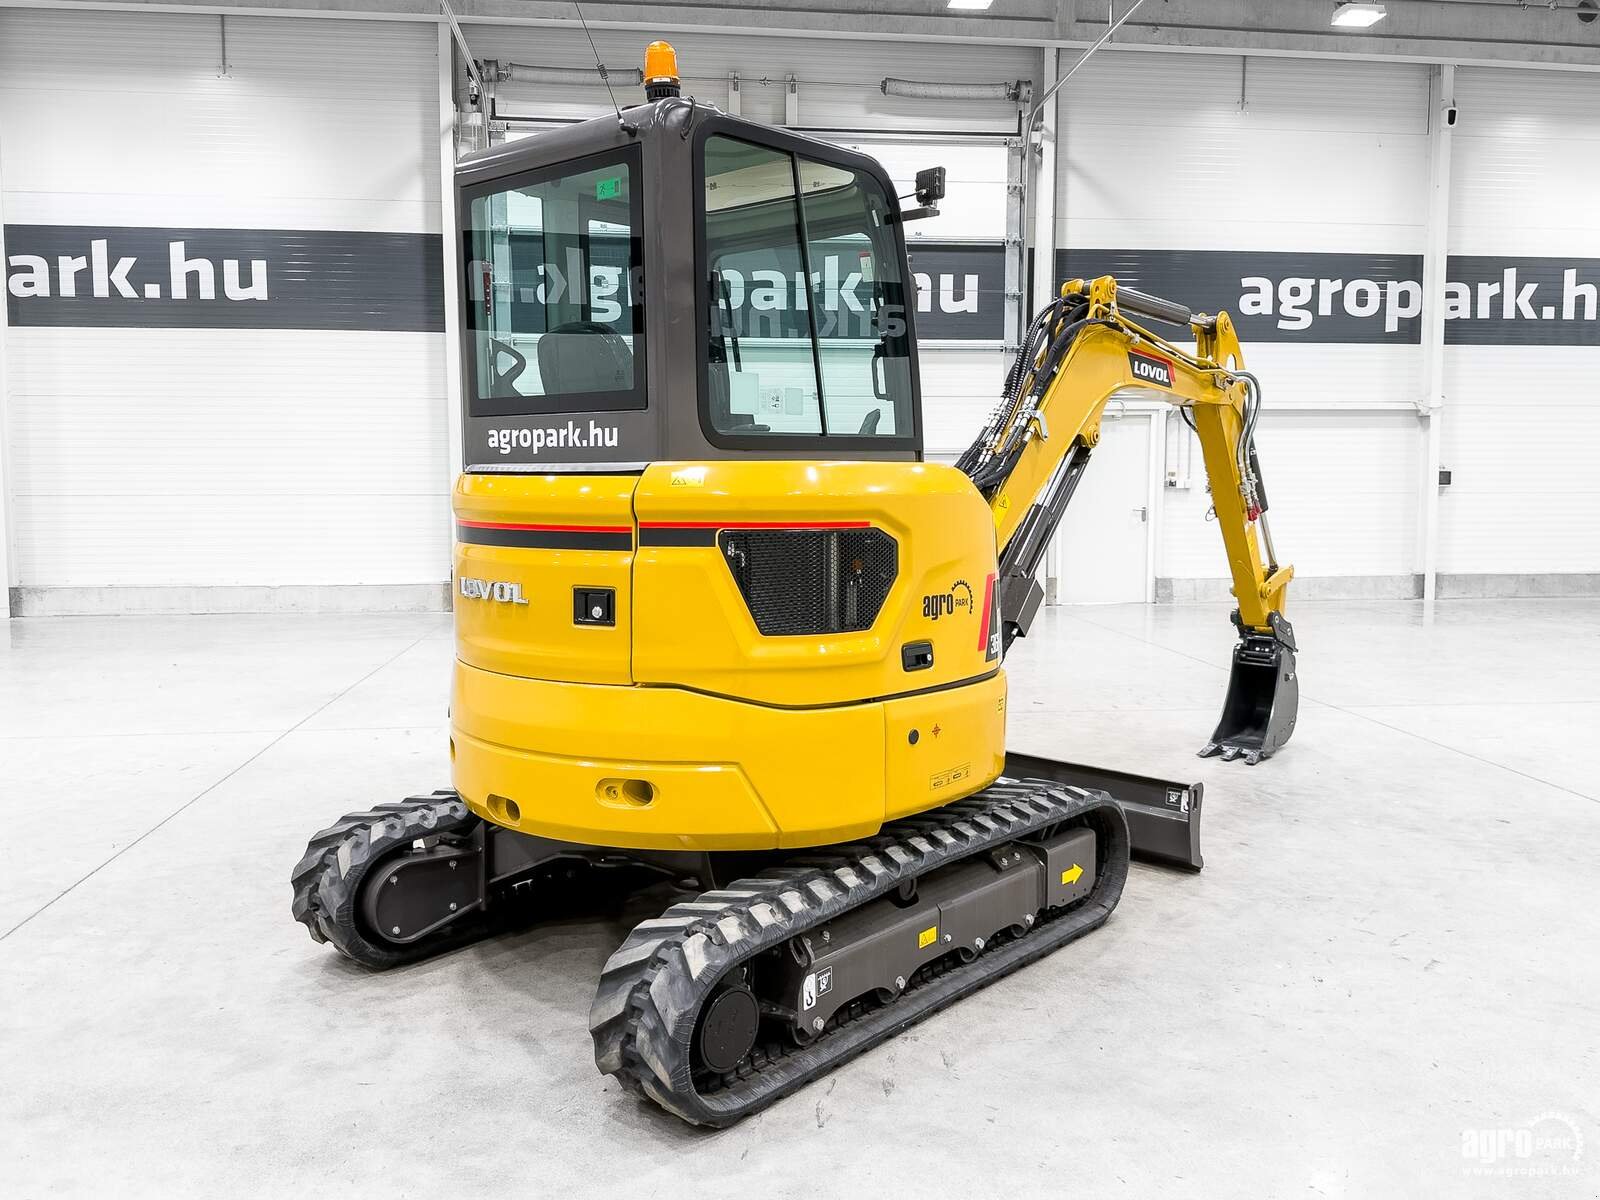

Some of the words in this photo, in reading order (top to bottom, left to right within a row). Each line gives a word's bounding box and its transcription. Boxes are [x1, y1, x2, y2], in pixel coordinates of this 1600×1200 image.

[8, 239, 268, 301] ark.hu
[1133, 361, 1169, 382] LOVOL
[488, 420, 618, 454] agropark.hu
[460, 576, 529, 604] LOVOL
[923, 593, 953, 620] agro
